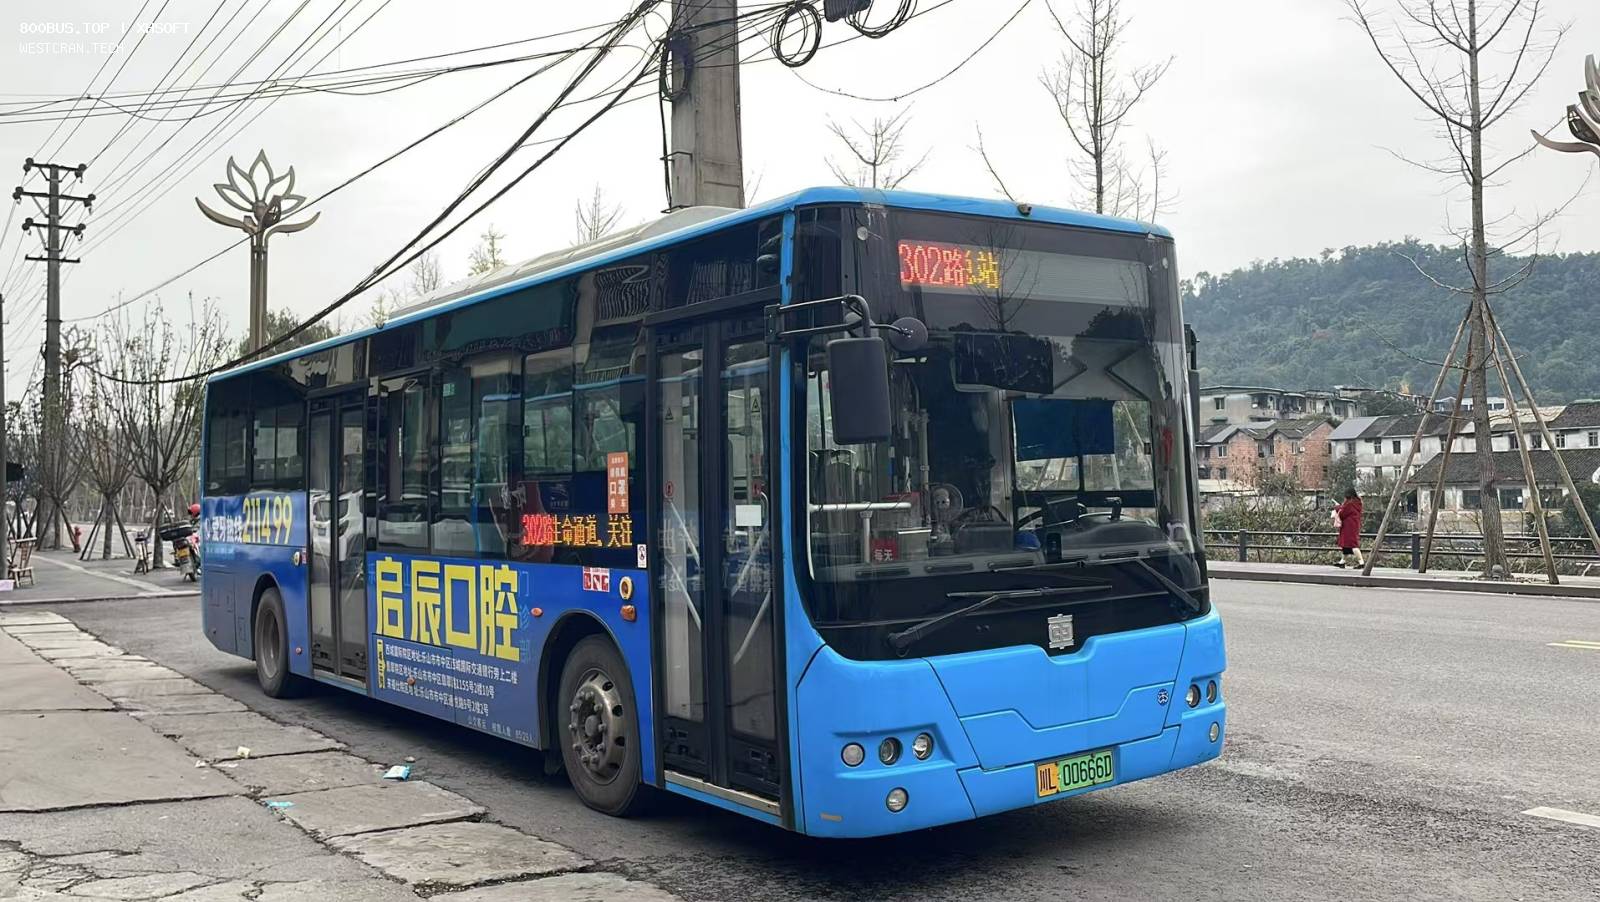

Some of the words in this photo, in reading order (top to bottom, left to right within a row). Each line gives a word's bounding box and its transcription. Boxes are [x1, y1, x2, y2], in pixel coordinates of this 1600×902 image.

[376, 556, 520, 662] 启辰口腔
[1063, 755, 1112, 787] 00666D
